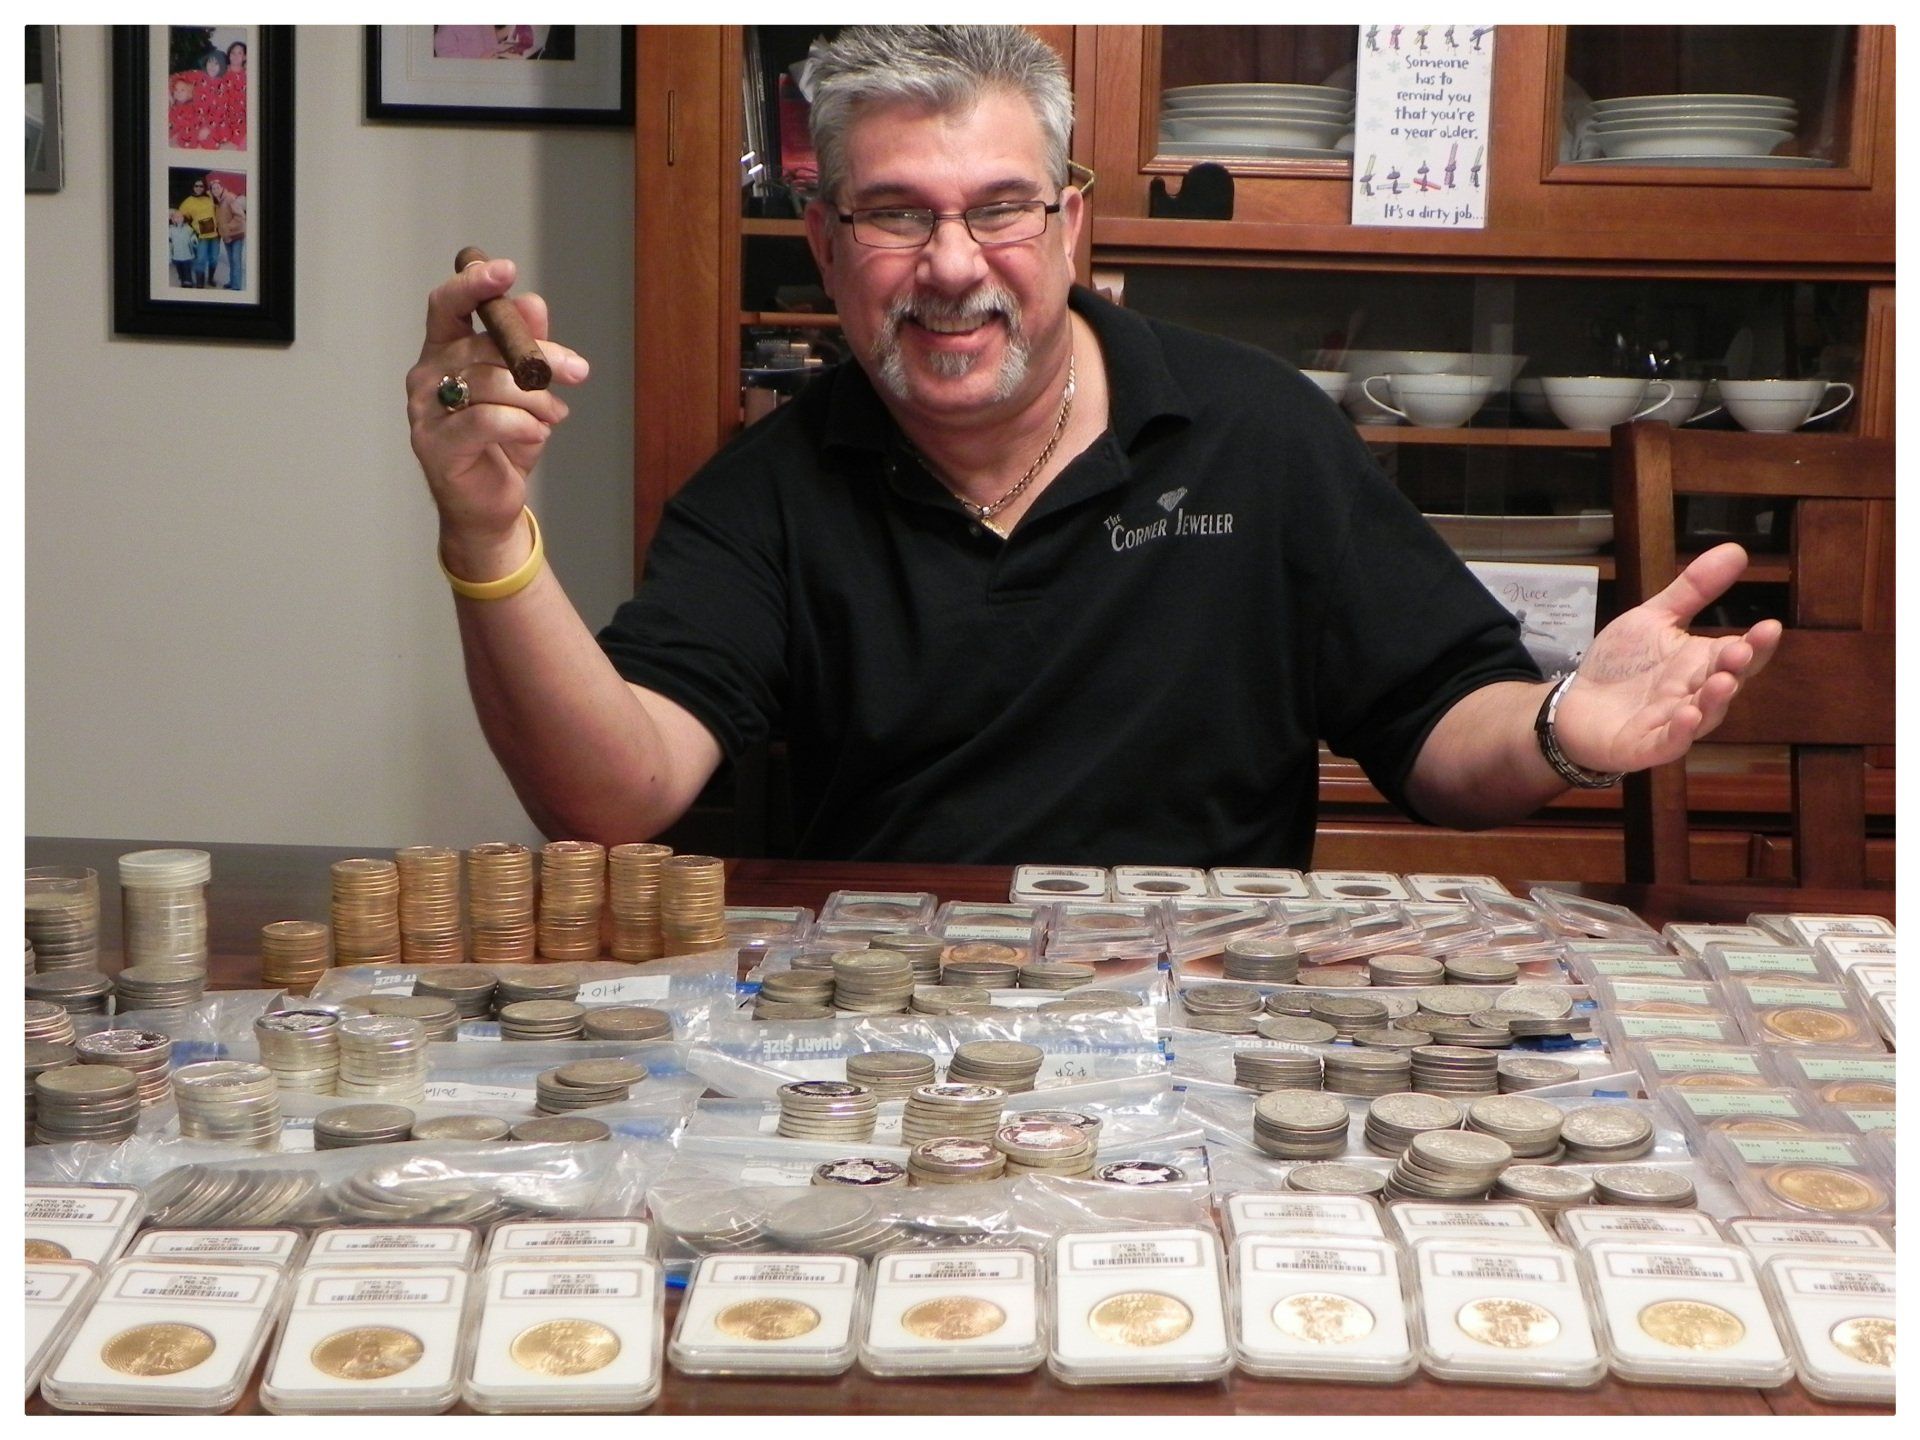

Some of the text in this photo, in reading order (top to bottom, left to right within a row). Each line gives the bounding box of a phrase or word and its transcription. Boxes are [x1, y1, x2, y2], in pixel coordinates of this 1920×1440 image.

[1405, 54, 1469, 69] Someone
[1416, 72, 1453, 85] has to
[1397, 89, 1472, 105] remind you
[1394, 106, 1475, 125] that you're
[1391, 125, 1479, 139] a year older.
[1384, 203, 1404, 218] It's
[1406, 208, 1415, 218] a
[1419, 205, 1450, 222] dirty
[1103, 513, 1122, 531] The
[1175, 508, 1234, 535] JEWELER
[1503, 582, 1549, 602] Niece
[763, 1036, 843, 1054] QUART SIZE
